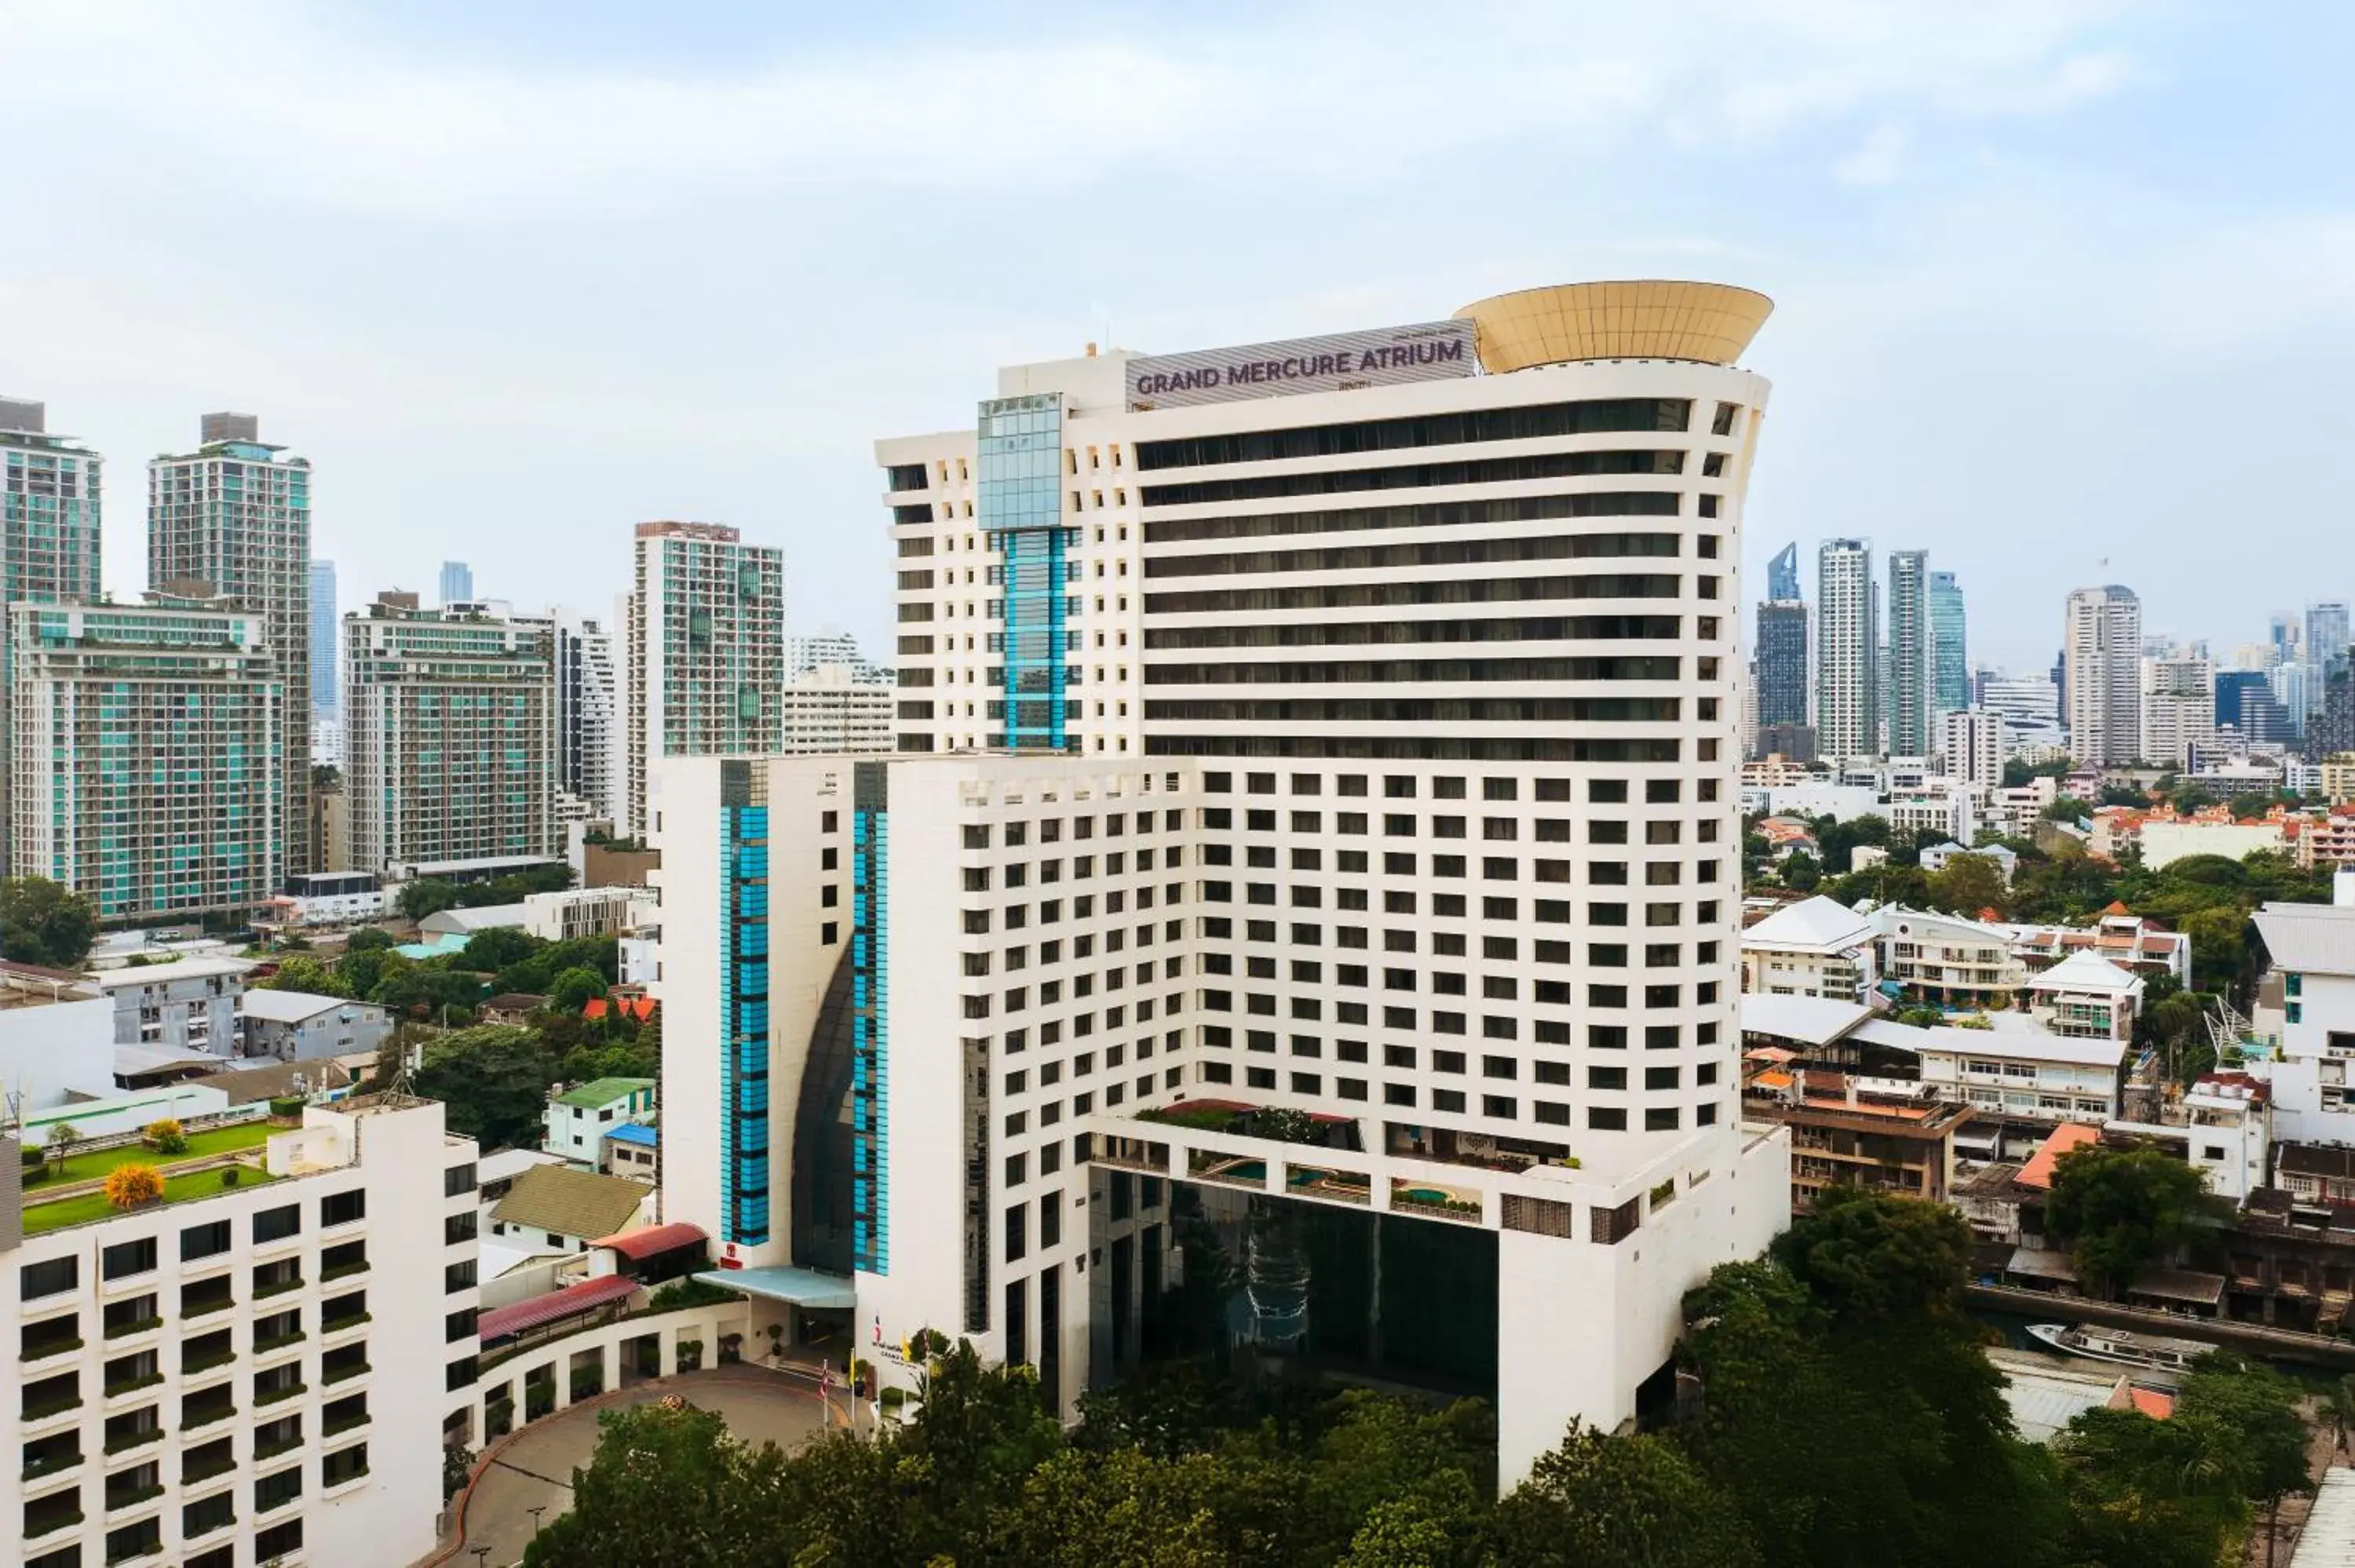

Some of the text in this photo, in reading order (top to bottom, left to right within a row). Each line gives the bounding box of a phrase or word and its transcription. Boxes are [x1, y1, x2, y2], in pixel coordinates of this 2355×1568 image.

[1137, 338, 1463, 395] GRAND MERCURE ATRIUM
